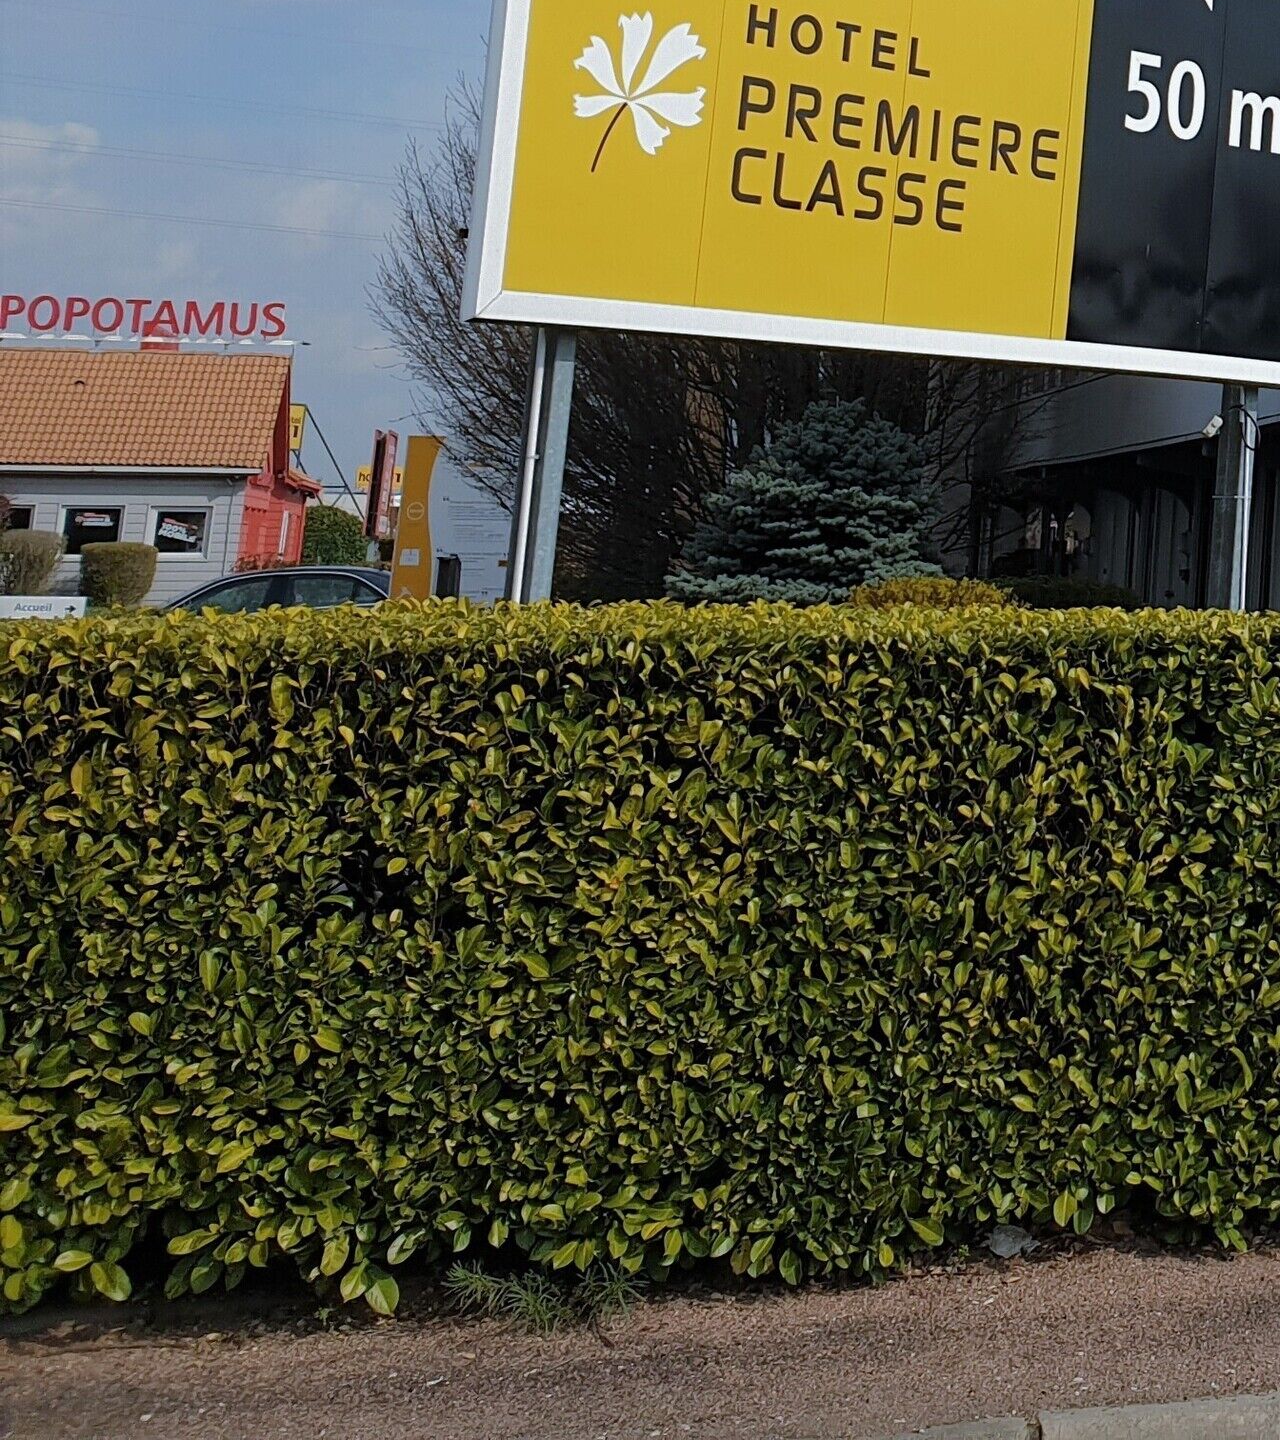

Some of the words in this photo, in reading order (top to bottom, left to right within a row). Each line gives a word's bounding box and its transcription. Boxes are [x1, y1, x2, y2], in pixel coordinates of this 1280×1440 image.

[746, 4, 931, 78] HOTEL
[738, 75, 1060, 181] PREMIERE
[1124, 50, 1206, 140] 50
[731, 147, 967, 232] CLASSE
